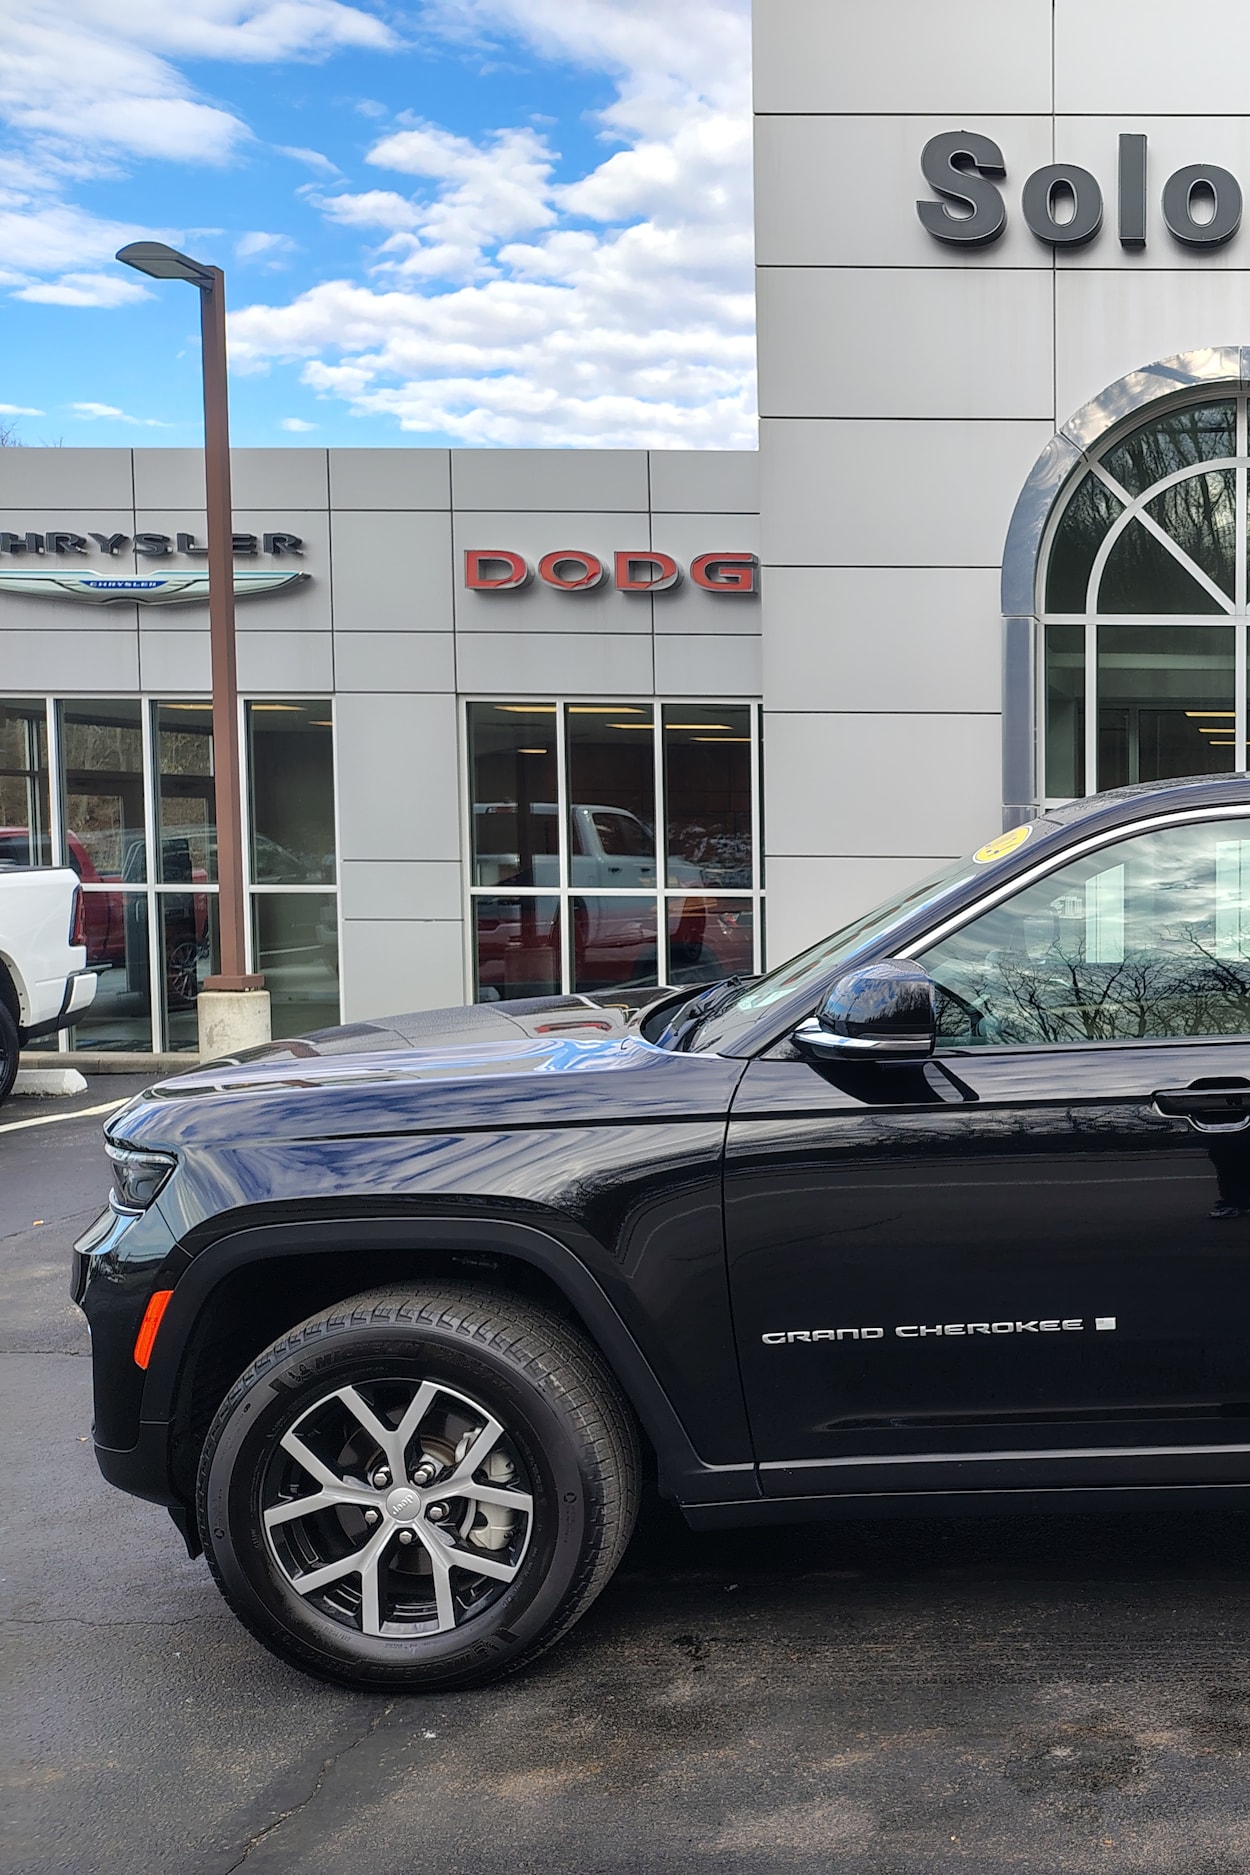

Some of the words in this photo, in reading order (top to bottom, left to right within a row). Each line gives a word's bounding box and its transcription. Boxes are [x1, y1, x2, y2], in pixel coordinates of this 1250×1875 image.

[0, 531, 304, 556] HRYSLER
[464, 550, 758, 595] DODG
[761, 1327, 884, 1345] GRAND
[895, 1318, 1084, 1338] CHEROKEE
